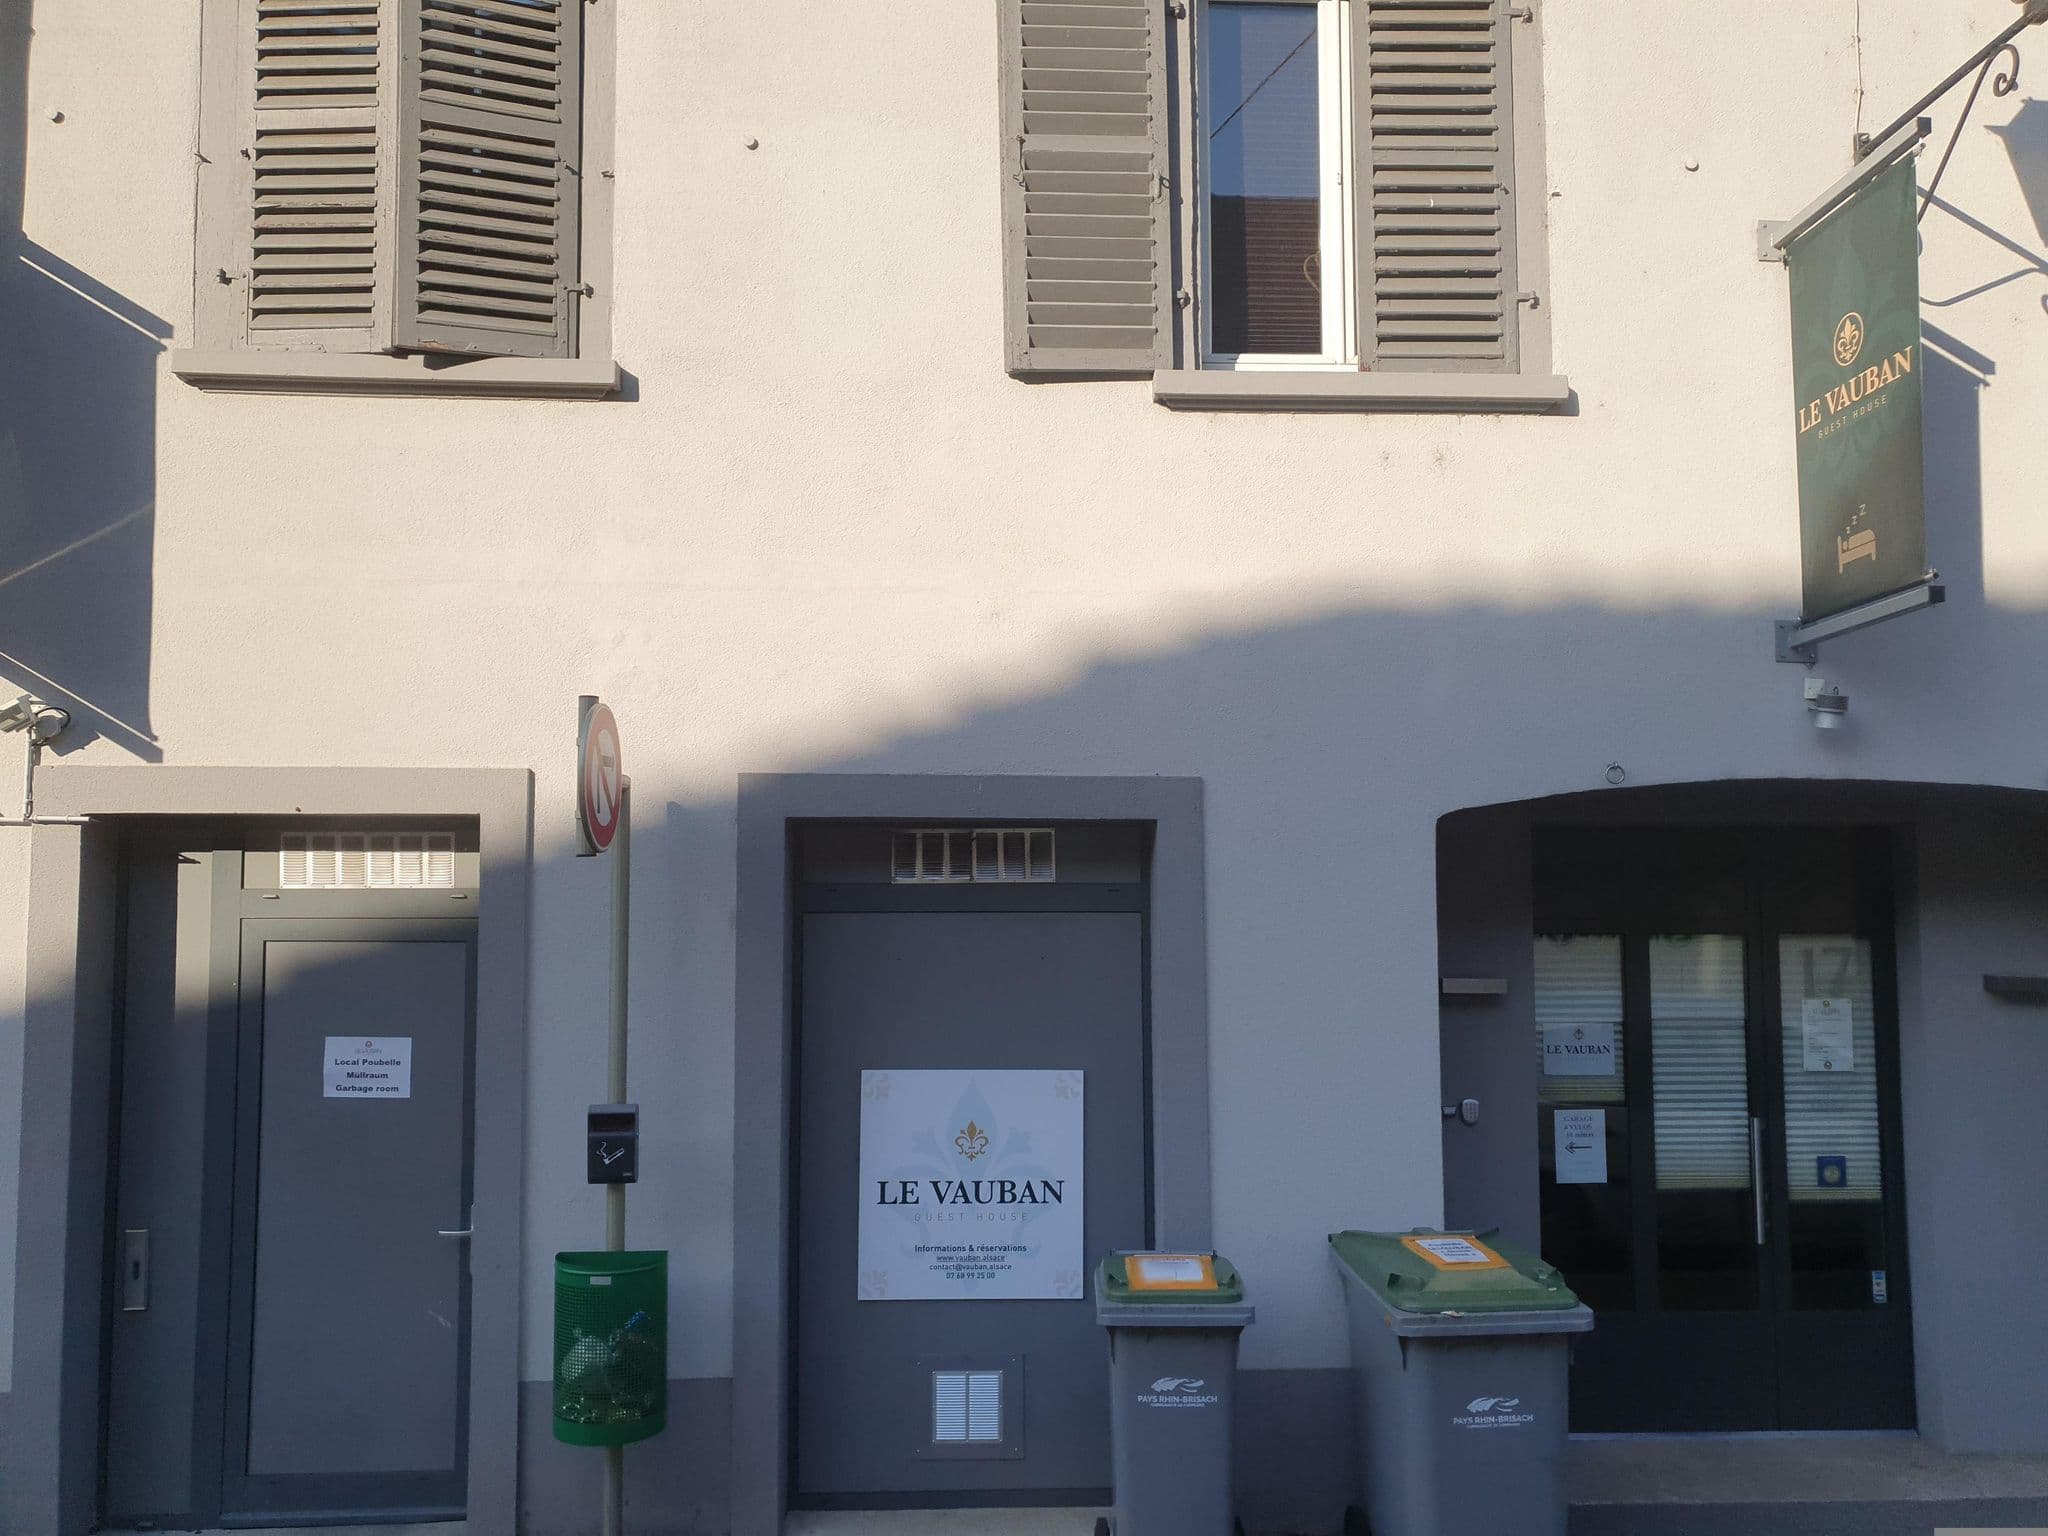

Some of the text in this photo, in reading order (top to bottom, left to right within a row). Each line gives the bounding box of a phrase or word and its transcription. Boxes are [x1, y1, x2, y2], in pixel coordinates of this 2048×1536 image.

[1798, 345, 1913, 434] LE VAUBAN
[1818, 394, 1888, 439] GUEST HOUSE
[1546, 1044, 1562, 1055] LE
[346, 1071, 389, 1079] Müllraum
[335, 1084, 373, 1093] Garbage
[877, 1180, 1065, 1205] LE VAUBAN
[914, 1212, 1028, 1221] GUEST HOUSE
[976, 1244, 1027, 1252] réservations
[929, 1263, 1012, 1271] contact@vauban.alsace
[1453, 1414, 1534, 1424] PAYS RHIN-BRISACH
